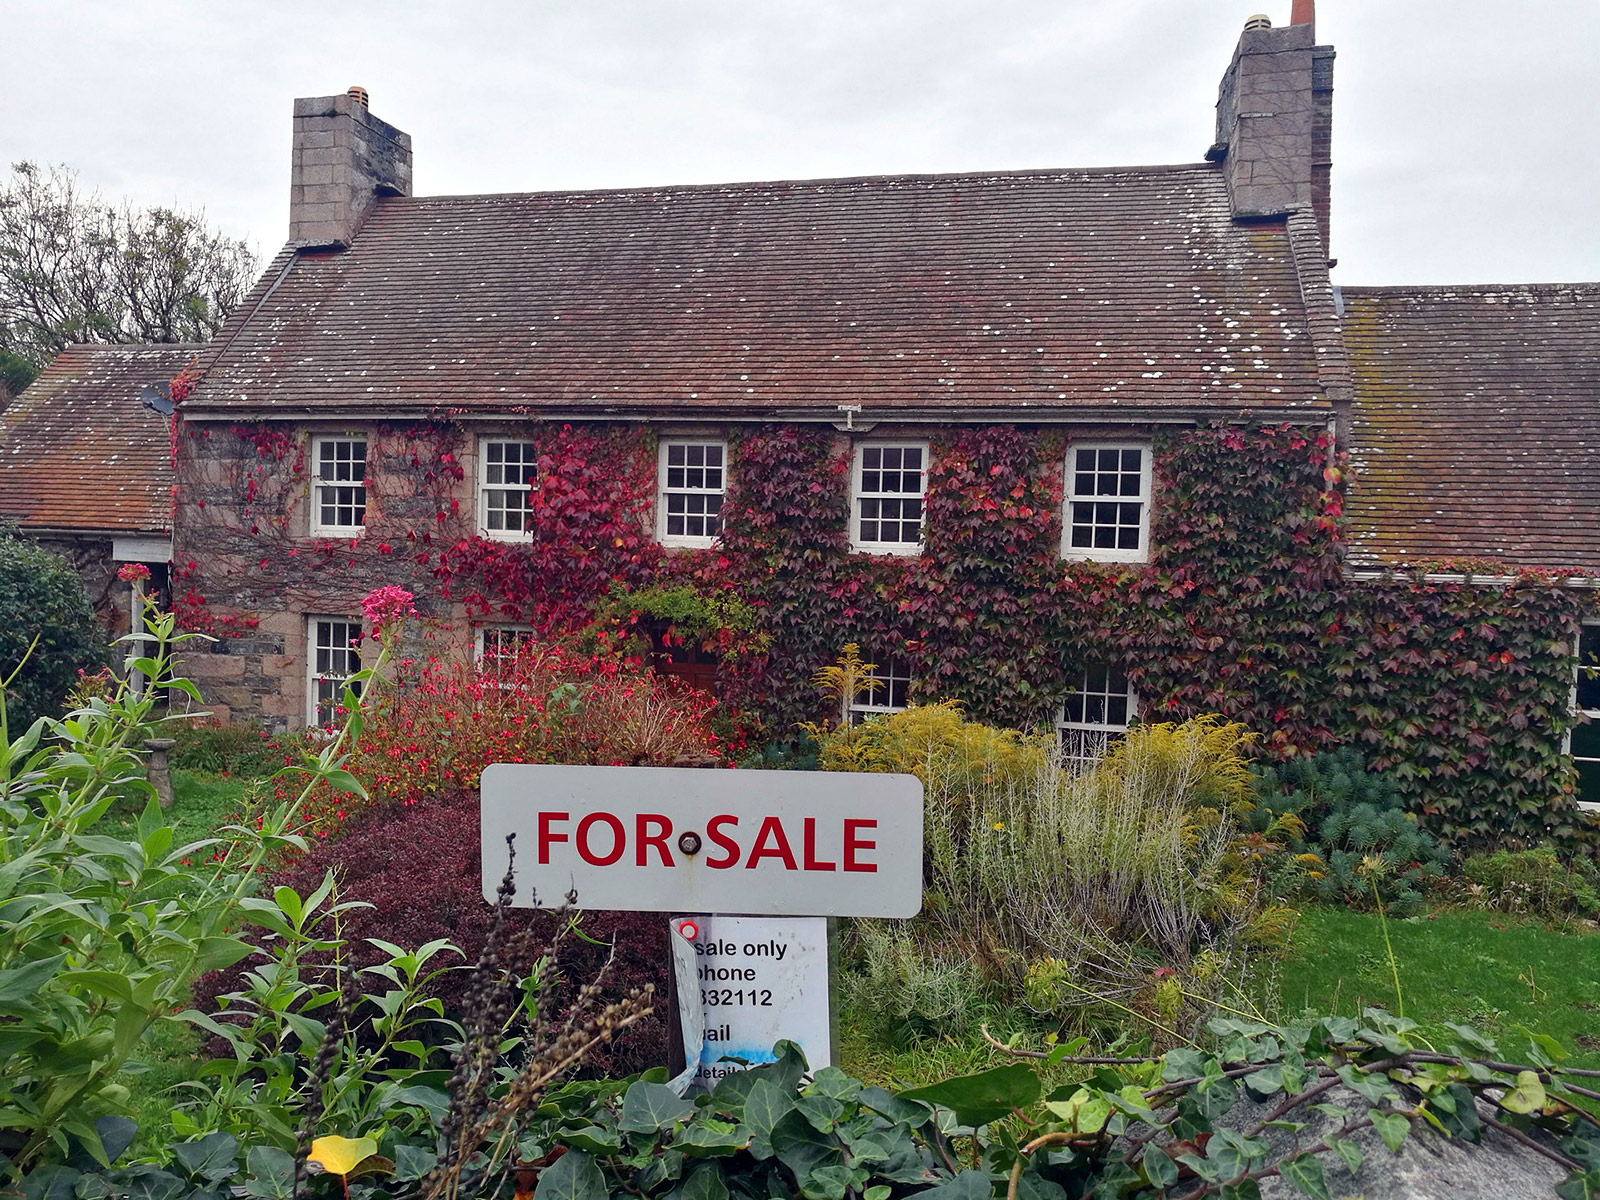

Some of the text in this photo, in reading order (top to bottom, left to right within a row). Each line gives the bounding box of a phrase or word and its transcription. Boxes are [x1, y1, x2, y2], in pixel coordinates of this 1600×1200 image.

[537, 811, 879, 873] FOR SALE
[694, 938, 788, 961] sale only
[703, 1024, 731, 1042] ail
[694, 1065, 742, 1079] detail
